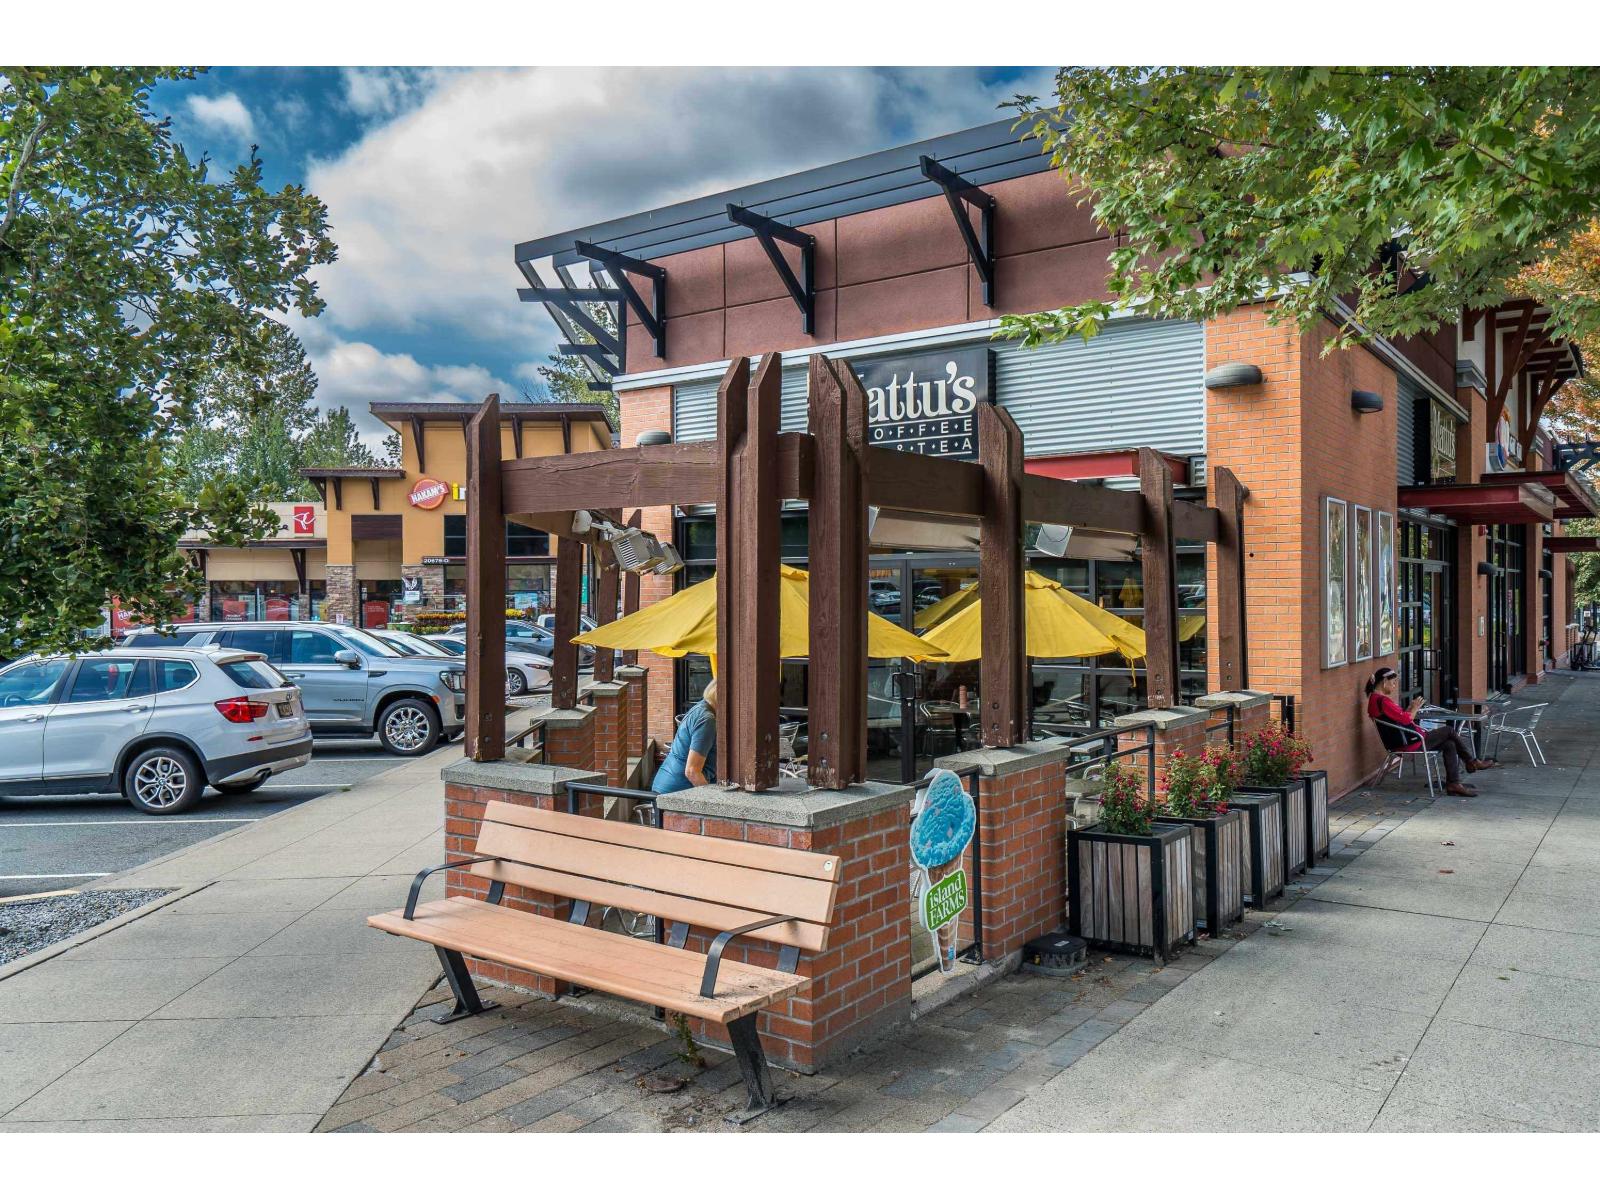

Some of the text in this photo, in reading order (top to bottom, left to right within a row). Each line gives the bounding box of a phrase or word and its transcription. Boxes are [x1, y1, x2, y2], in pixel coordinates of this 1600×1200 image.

[857, 360, 977, 422] attu's
[873, 419, 973, 440] OFFEE
[918, 438, 973, 454] TEA
[411, 482, 446, 504] HAKAM'S
[930, 873, 963, 909] island
[930, 889, 966, 927] FARMS
